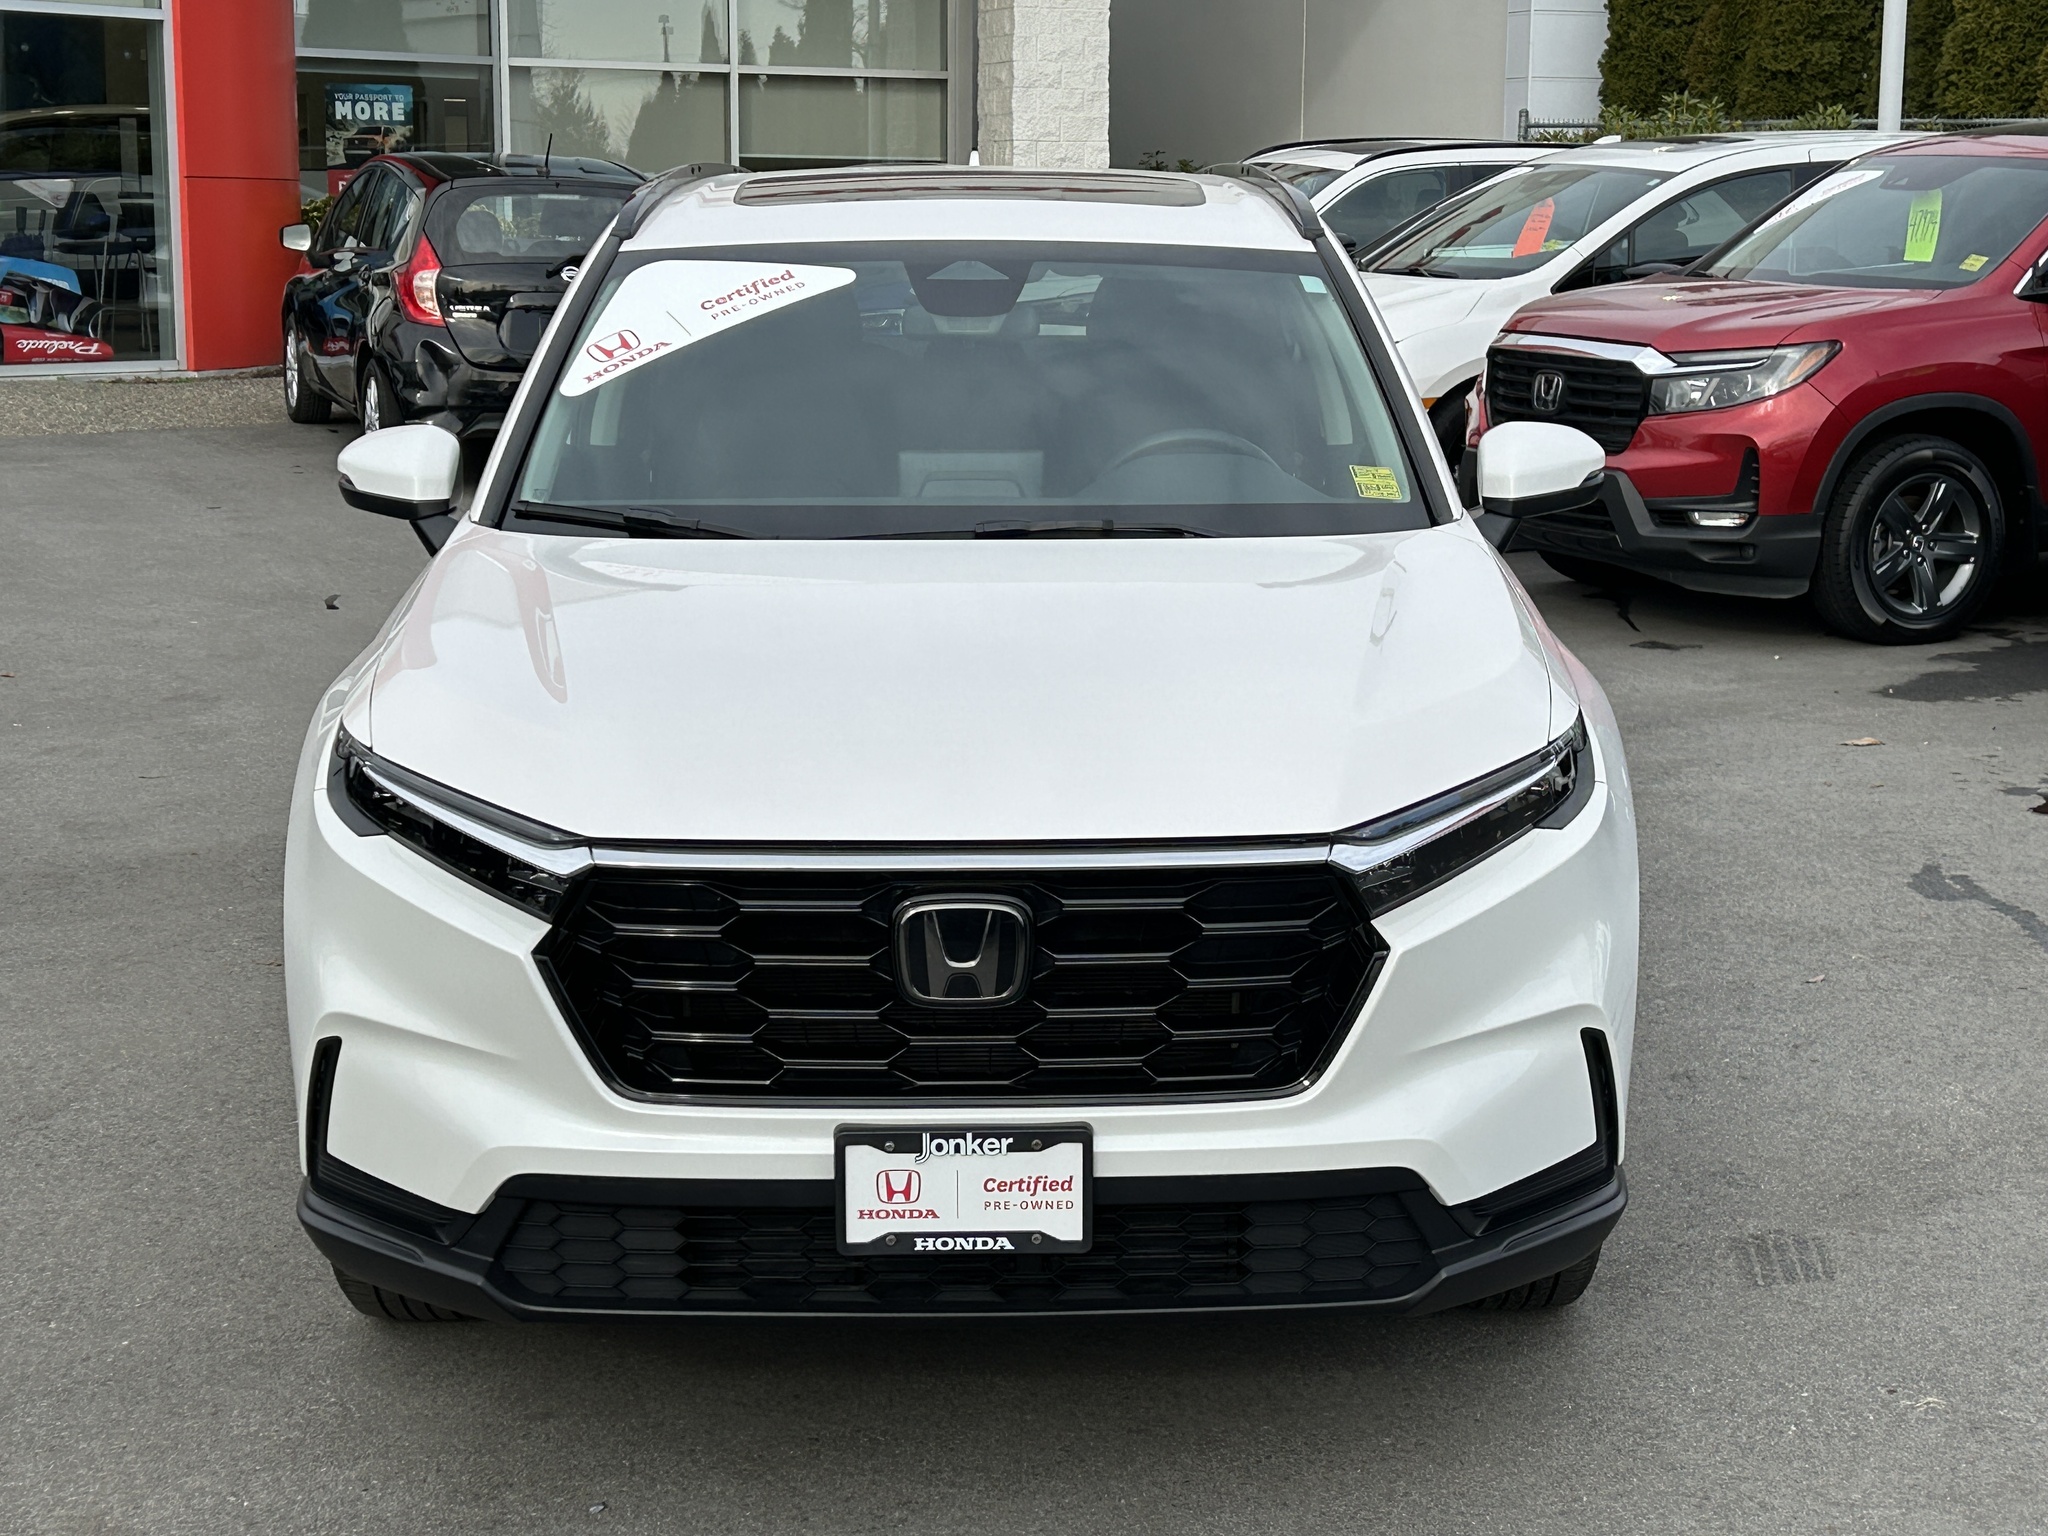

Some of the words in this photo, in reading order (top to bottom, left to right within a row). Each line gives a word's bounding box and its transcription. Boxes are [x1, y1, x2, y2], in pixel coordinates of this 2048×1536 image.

[355, 93, 392, 101] PASSPORT
[395, 94, 405, 102] TO
[334, 101, 405, 120] MORE
[700, 270, 796, 311] Certified
[711, 281, 806, 321] PRE-OWNED
[16, 339, 102, 355] Prelude
[583, 341, 673, 384] HONDA
[914, 1132, 1014, 1164] Jonker
[983, 1175, 1074, 1197] Certified
[857, 1208, 940, 1220] HONDA
[984, 1200, 1074, 1211] PRE-OWNED
[914, 1236, 1015, 1252] HONDA
